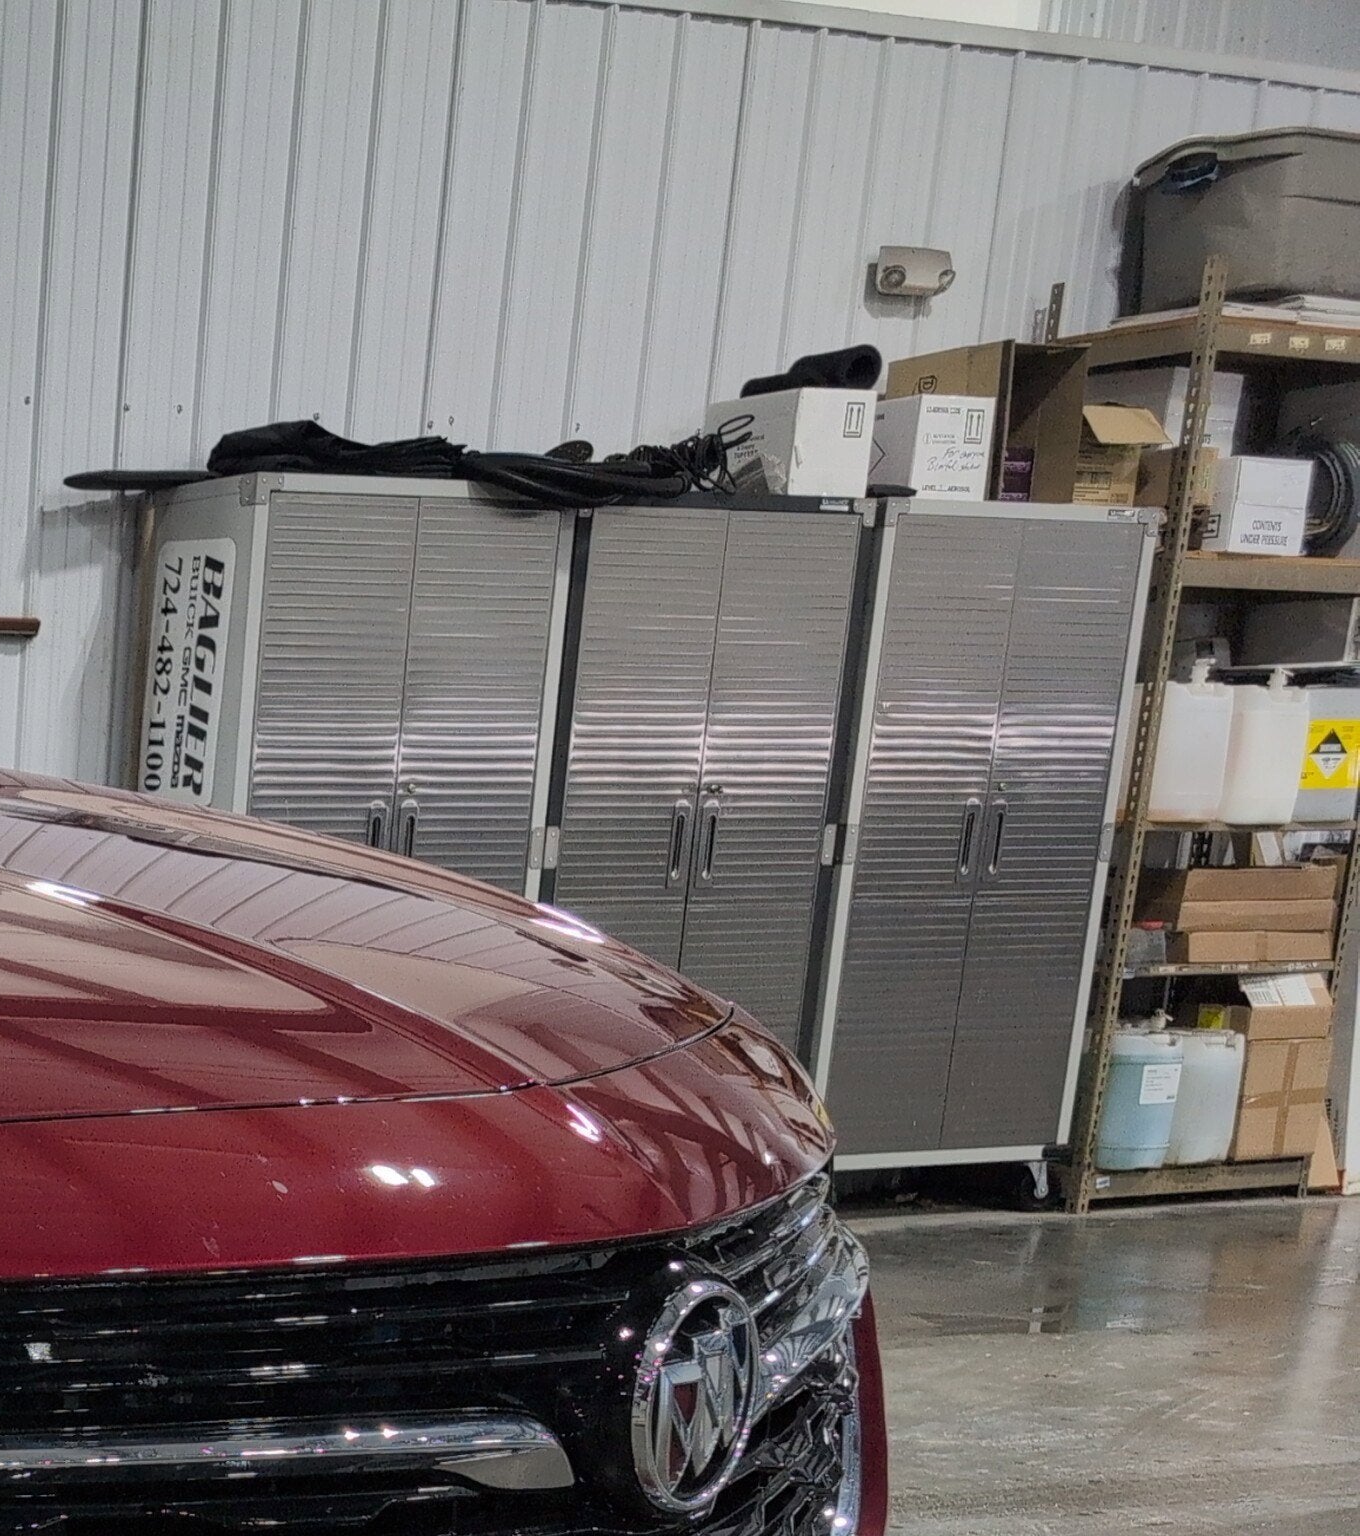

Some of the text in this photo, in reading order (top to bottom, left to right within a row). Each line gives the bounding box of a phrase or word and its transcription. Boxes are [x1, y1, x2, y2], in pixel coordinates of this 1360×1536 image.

[143, 556, 184, 793] 724-482-1100
[177, 646, 192, 707] GMC
[181, 554, 225, 797] BAGLIER
[184, 555, 201, 640] BUICK
